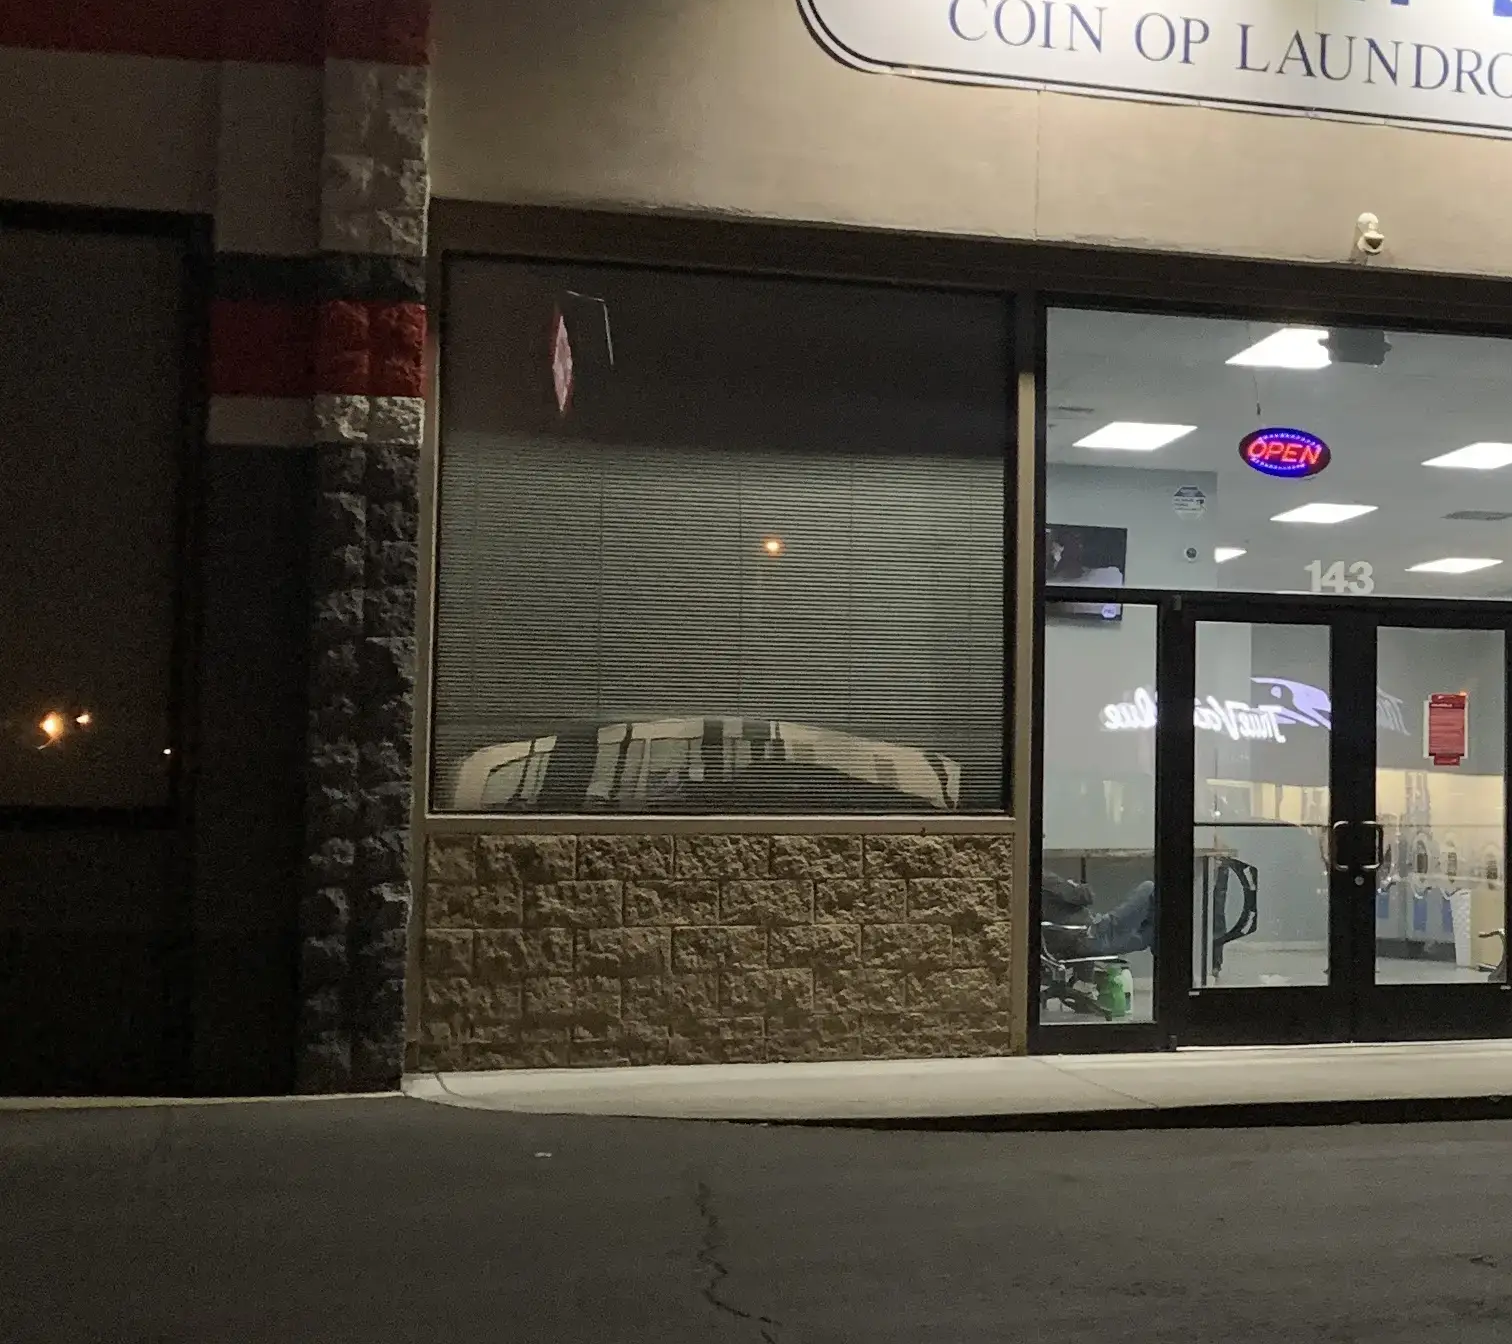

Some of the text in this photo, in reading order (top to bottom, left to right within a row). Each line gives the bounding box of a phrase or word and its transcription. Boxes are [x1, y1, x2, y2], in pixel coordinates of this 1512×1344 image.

[1134, 12, 1210, 65] OP
[1247, 439, 1323, 465] OPEN
[1304, 560, 1375, 595] 143
